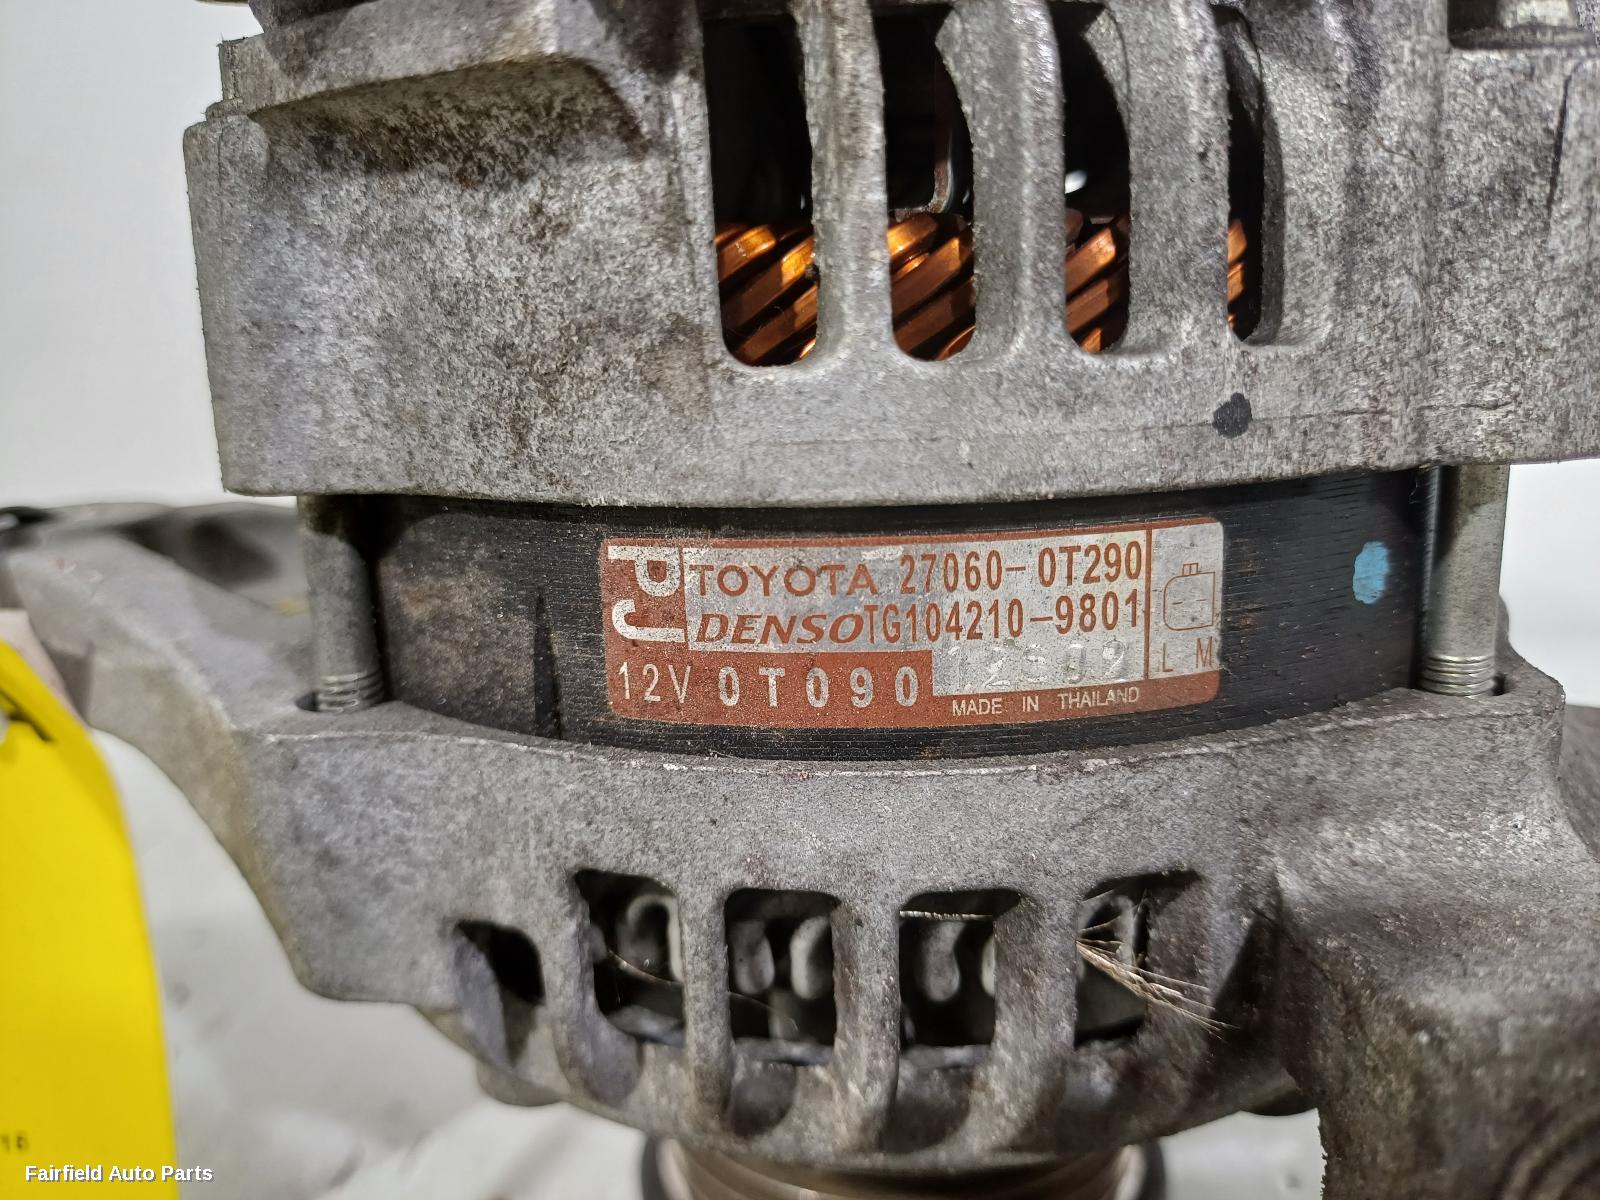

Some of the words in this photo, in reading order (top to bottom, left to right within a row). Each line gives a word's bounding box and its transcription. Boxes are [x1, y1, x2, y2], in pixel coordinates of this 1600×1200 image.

[689, 563, 878, 597] TOYOTA
[695, 613, 864, 645] DENSO
[864, 588, 1139, 644] TG104210-9801
[1162, 642, 1174, 673] L
[1196, 636, 1217, 669] M
[617, 661, 692, 704] 12V
[952, 698, 1003, 717] MADE
[1022, 695, 1040, 712] IN
[1058, 686, 1141, 711] THAILAND
